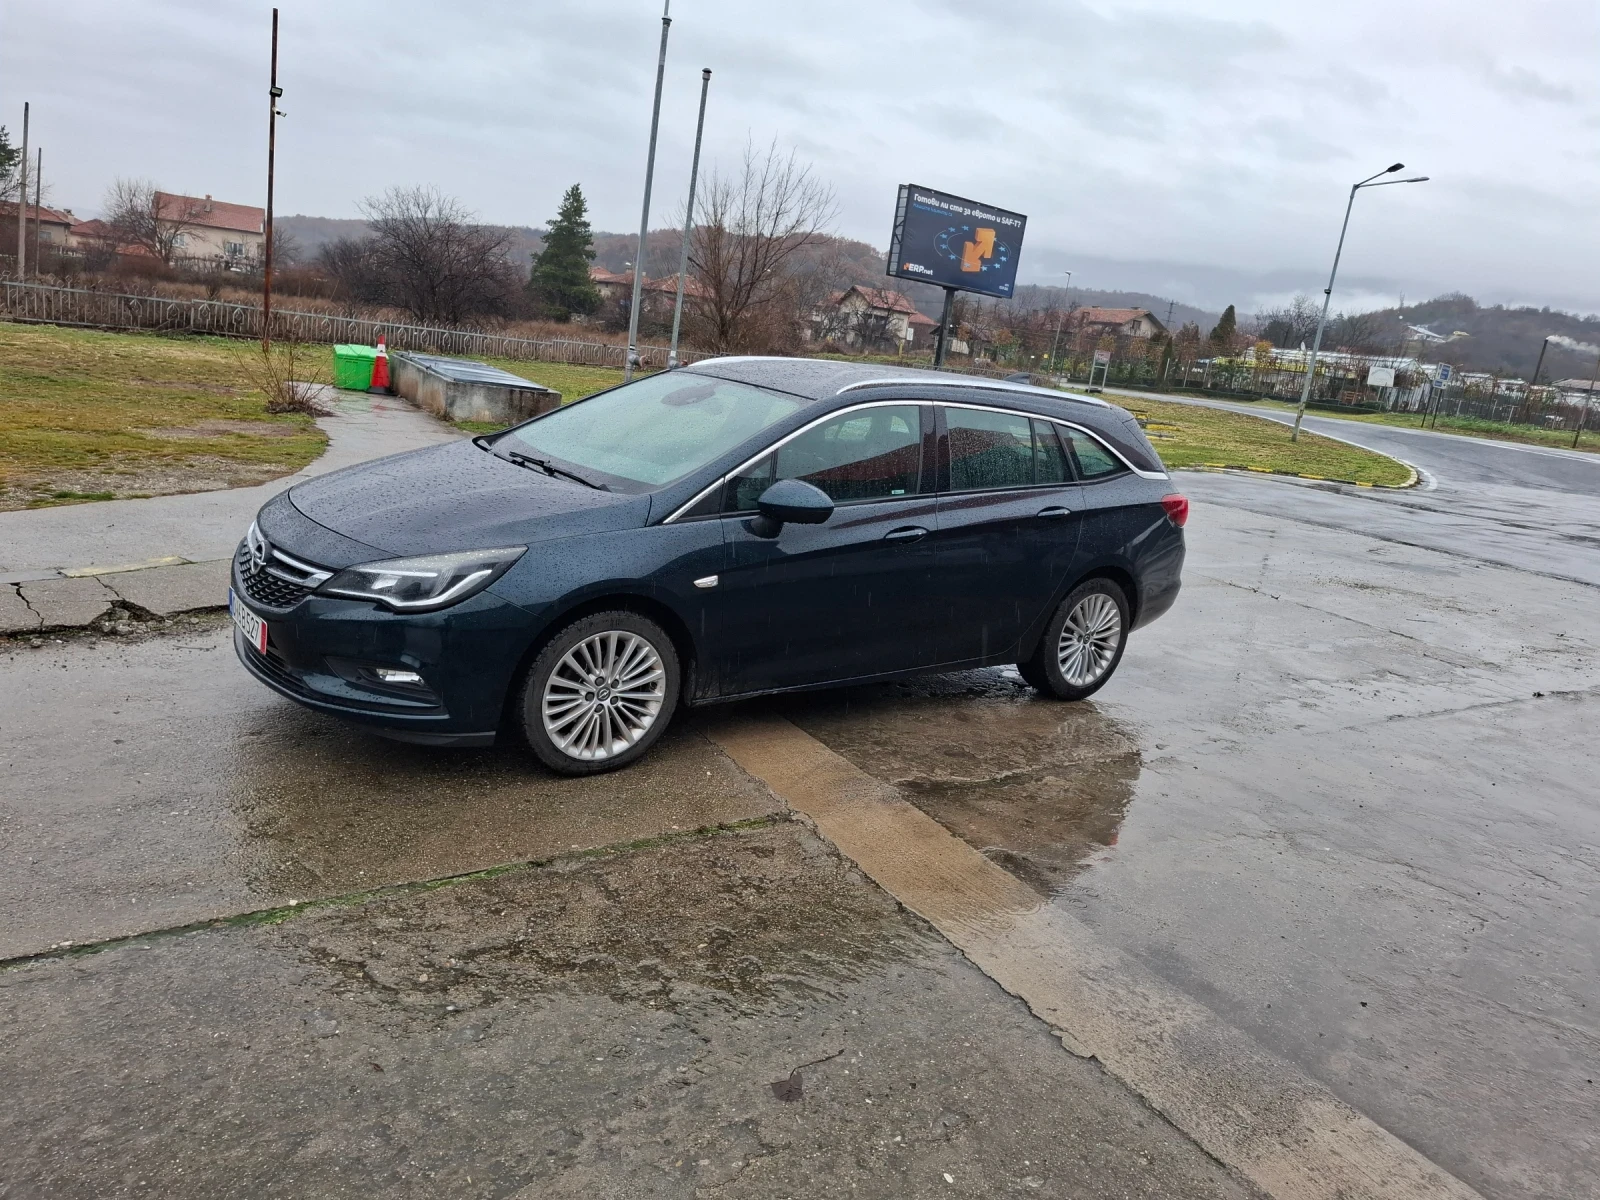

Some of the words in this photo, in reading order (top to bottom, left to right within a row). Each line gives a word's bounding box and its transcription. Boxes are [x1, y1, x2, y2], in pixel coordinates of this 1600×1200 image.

[914, 194, 940, 206] Готови
[940, 202, 949, 210] ли
[950, 204, 963, 213] сте
[963, 208, 971, 216] за
[972, 210, 996, 222] еврото
[1001, 216, 1022, 228] SAF-T?
[908, 263, 933, 276] ERP.net
